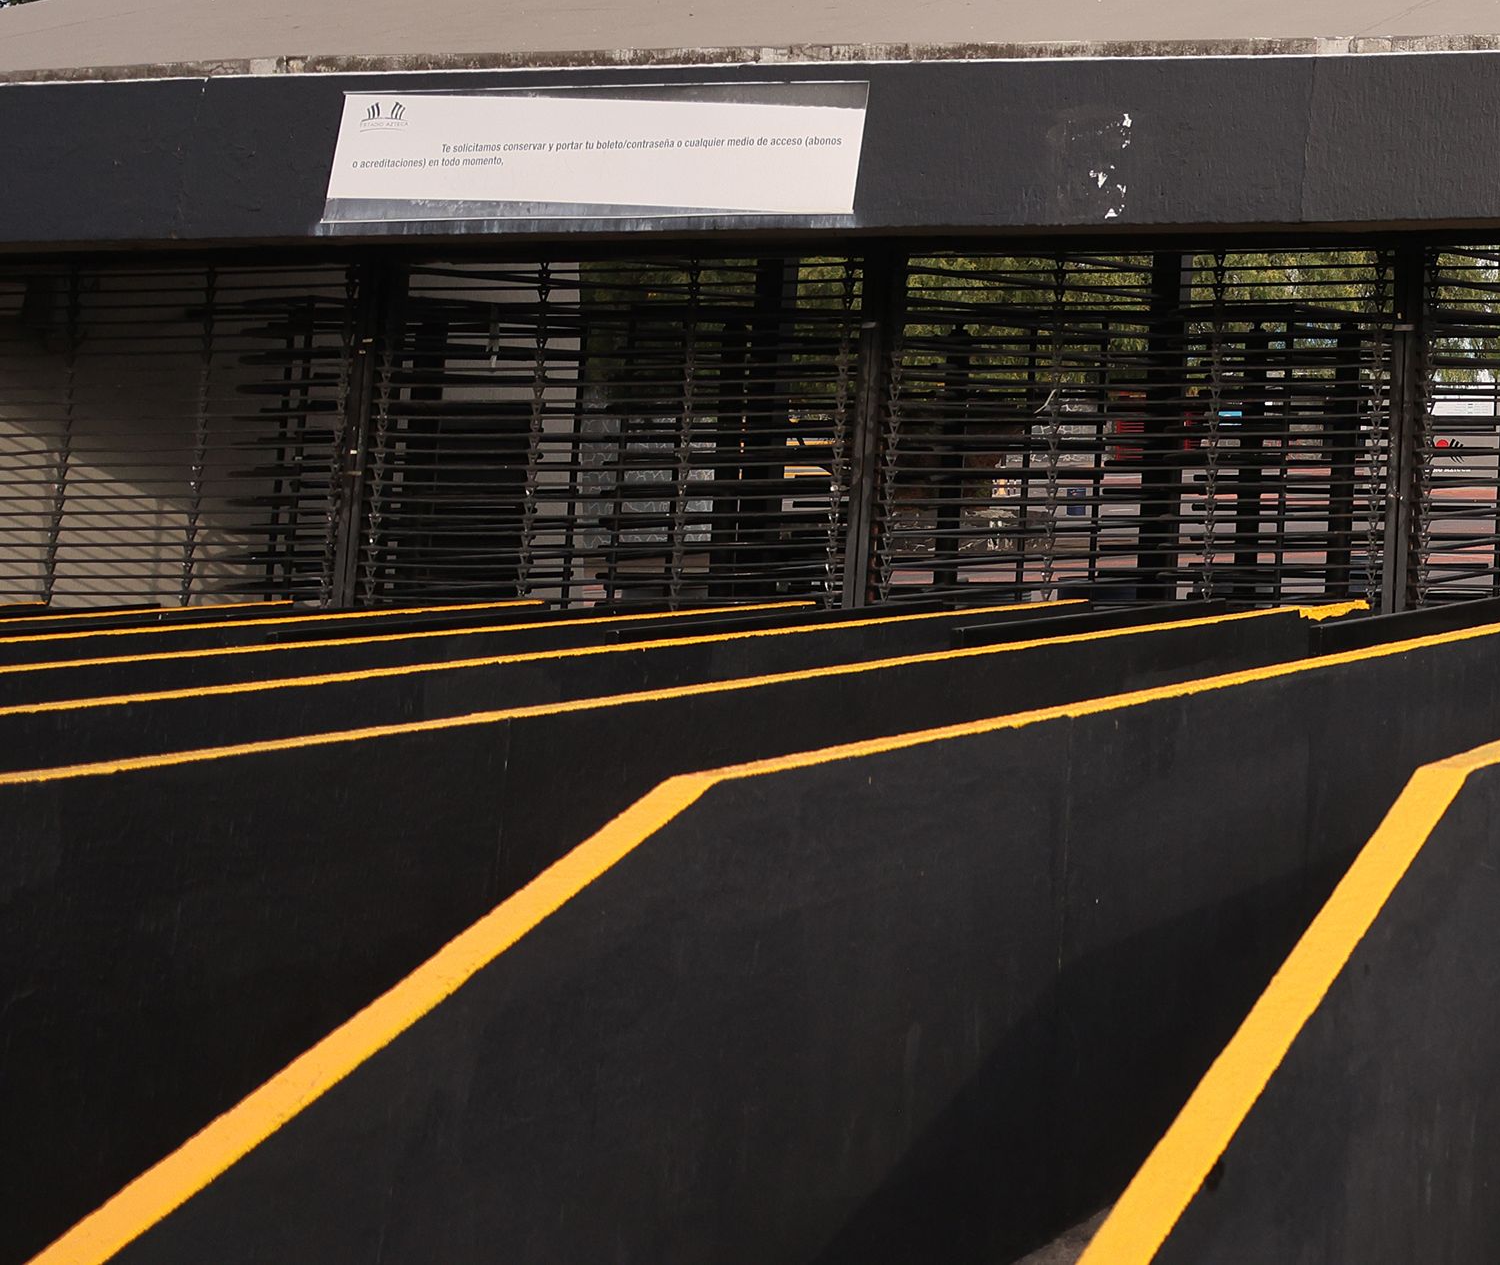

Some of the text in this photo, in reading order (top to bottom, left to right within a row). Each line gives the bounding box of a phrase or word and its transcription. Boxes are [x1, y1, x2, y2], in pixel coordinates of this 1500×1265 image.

[442, 144, 451, 153] Te
[453, 143, 501, 153] solicitamos
[503, 142, 546, 152] conservar
[548, 143, 554, 152] y
[556, 141, 583, 152] portar
[585, 141, 594, 149] tu
[596, 138, 675, 150] boleto/contraseña
[684, 137, 726, 149] cualquier
[728, 136, 754, 146] medio
[757, 137, 768, 146] de
[770, 136, 802, 148] acceso
[805, 134, 842, 147] (abonos
[360, 158, 426, 168] acreditaciones)
[442, 155, 460, 166] todo
[463, 156, 504, 166] momento,
